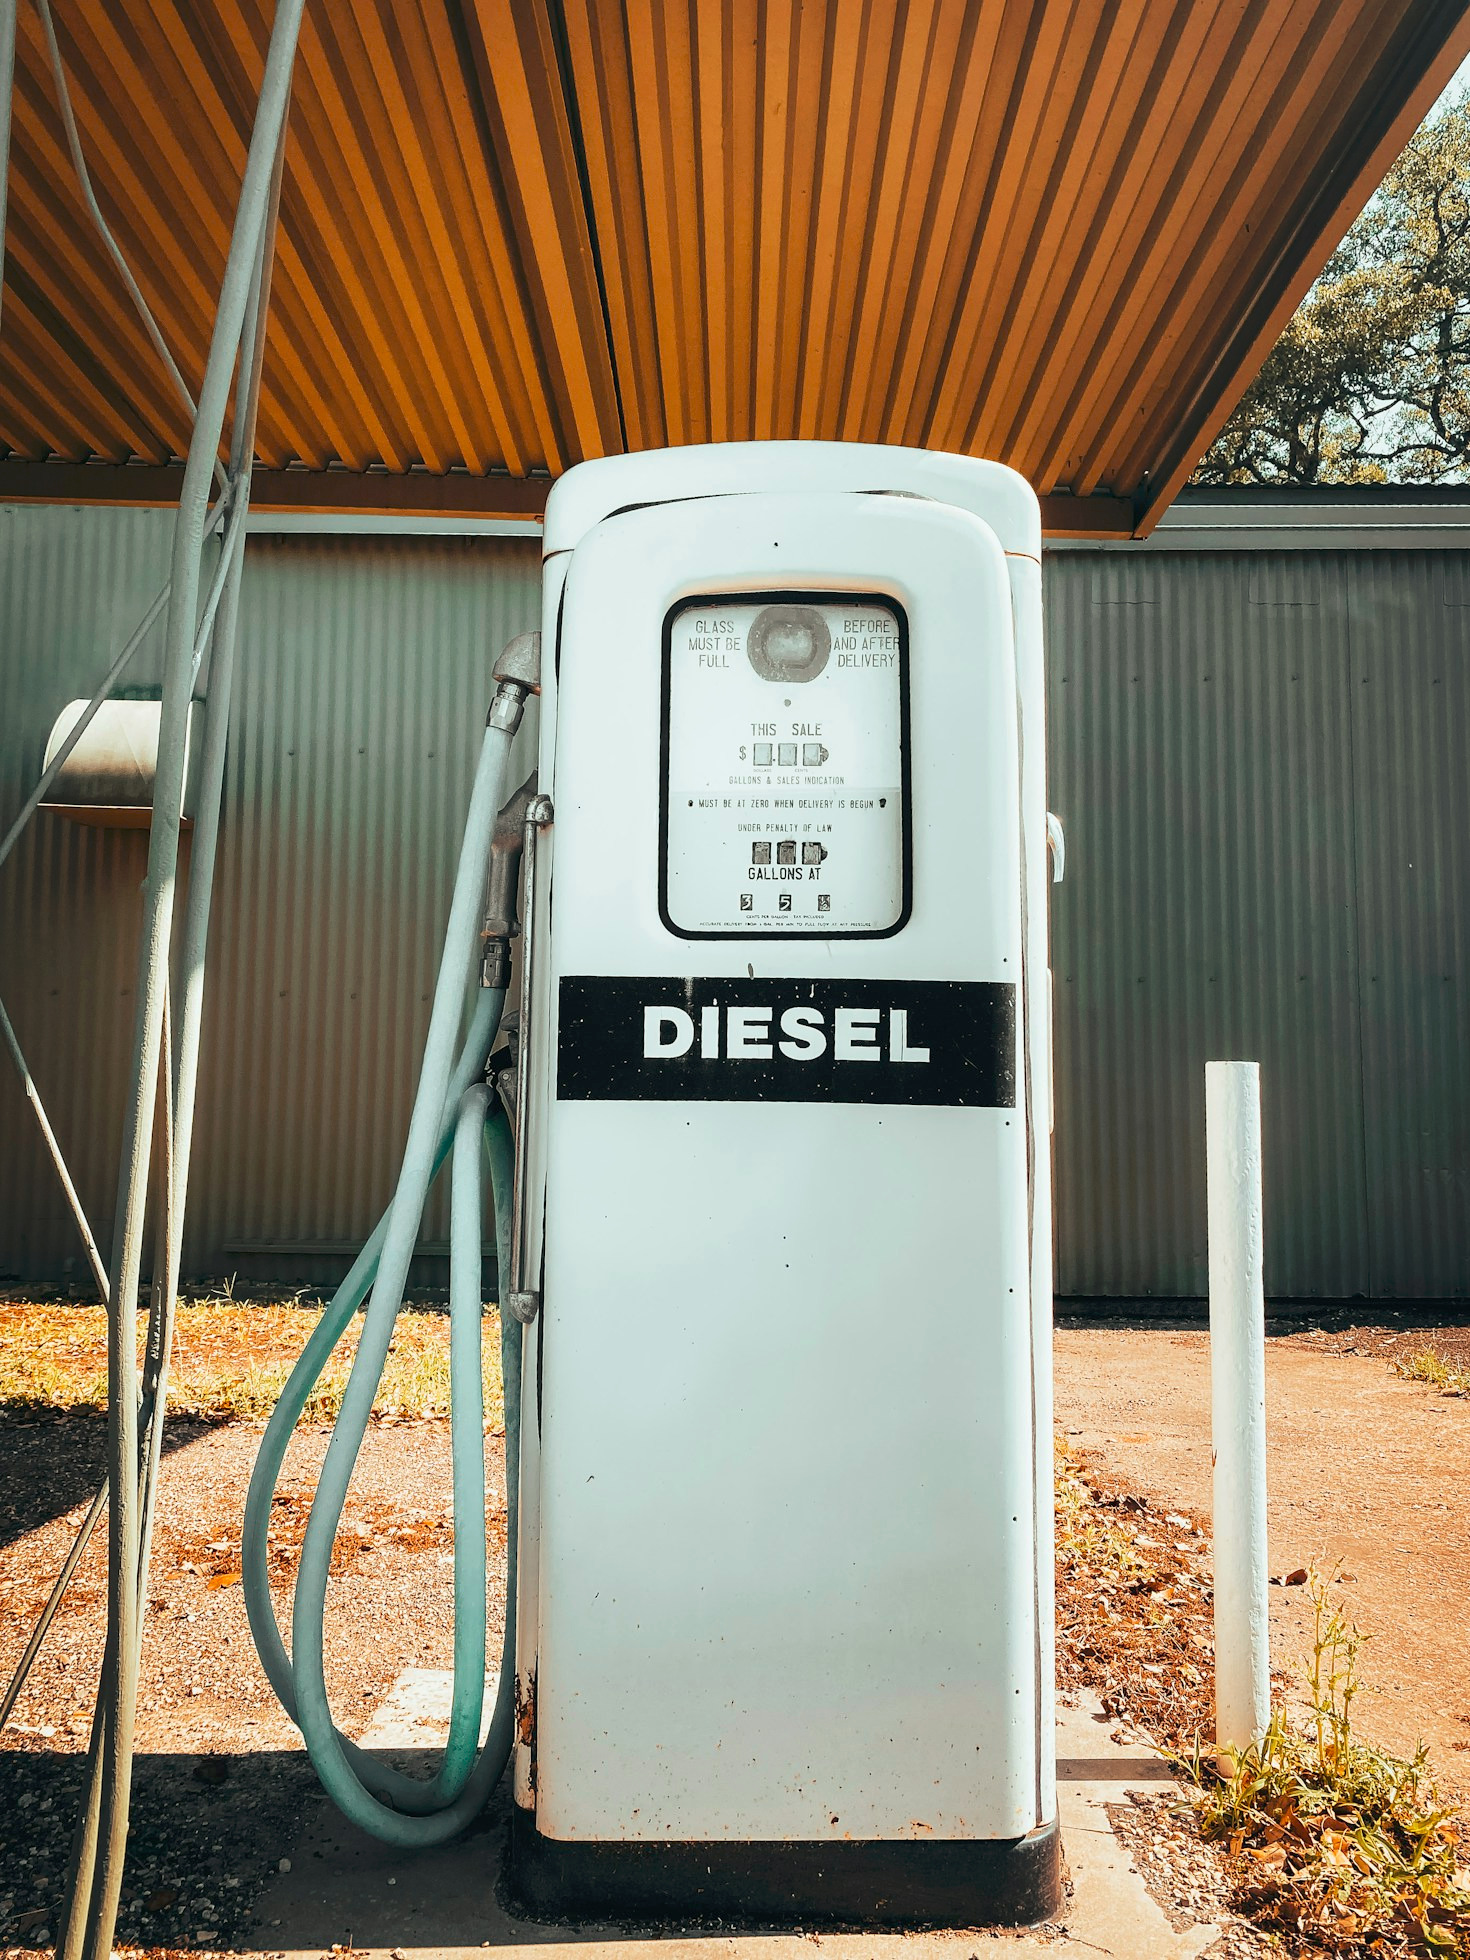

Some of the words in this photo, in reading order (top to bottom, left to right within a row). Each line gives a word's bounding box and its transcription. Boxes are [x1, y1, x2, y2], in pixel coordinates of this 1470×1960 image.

[696, 621, 734, 633] GLASS
[844, 620, 890, 633] BEFORE
[689, 638, 721, 650] MUST
[726, 638, 740, 650] BE
[834, 637, 857, 650] AND
[862, 637, 899, 650] AFTER
[699, 655, 729, 668] FULL
[838, 654, 896, 667] DELIVERY
[751, 723, 776, 736] THIS
[792, 723, 822, 736] SALE
[739, 746, 746, 760] $
[729, 776, 761, 785] GALLONS
[777, 777, 800, 785] SALES
[805, 777, 844, 785] INDICATION
[699, 800, 718, 808] MUST
[723, 800, 732, 808] BE
[737, 800, 745, 808] AT
[751, 800, 769, 808] ZERO
[774, 800, 794, 808] WHEN
[799, 800, 833, 808] DELIVERY
[838, 800, 845, 808] IS
[738, 824, 761, 832] UNDER
[766, 824, 798, 832] PENALTY
[803, 824, 811, 832] OF
[817, 824, 832, 832] LAW
[748, 868, 802, 880] GALLONS
[809, 868, 821, 880] AT
[742, 895, 751, 909] 3
[781, 897, 790, 910] 5
[643, 1005, 930, 1063] DIESEL
